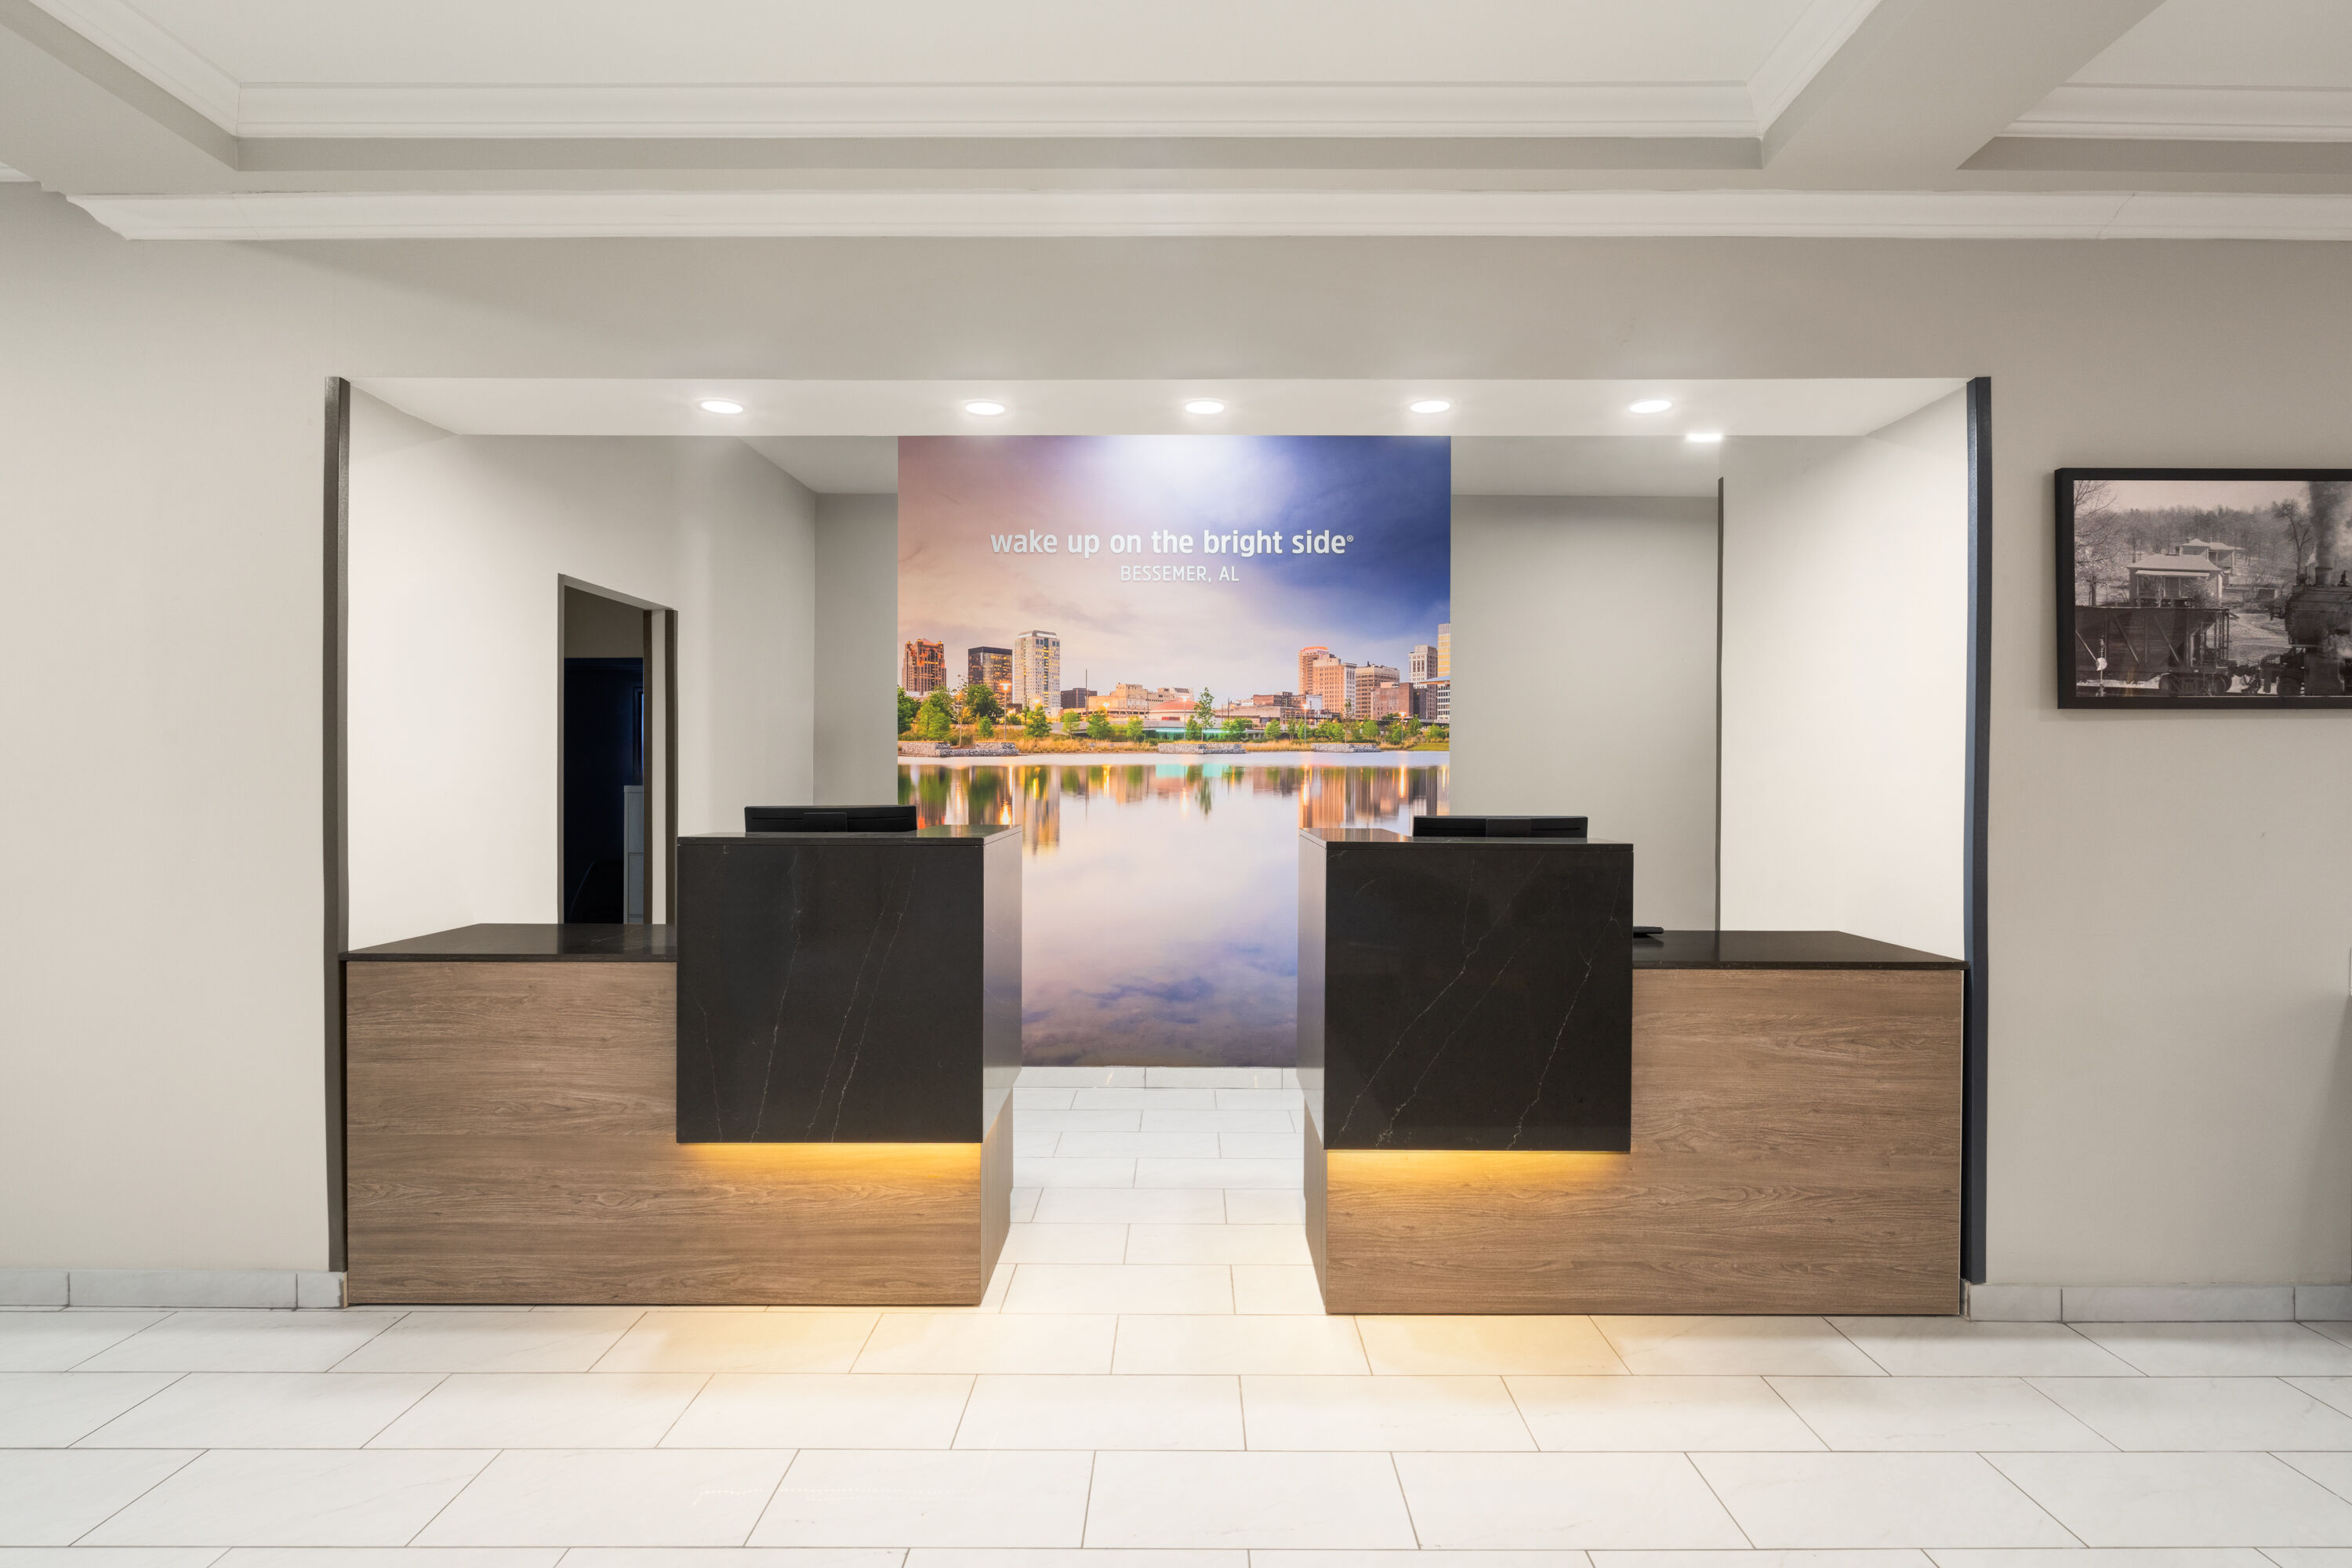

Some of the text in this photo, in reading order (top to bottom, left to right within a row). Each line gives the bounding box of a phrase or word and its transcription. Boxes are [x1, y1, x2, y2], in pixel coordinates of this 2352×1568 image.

[990, 529, 1058, 553] wake
[1067, 534, 1100, 558] up
[1109, 534, 1142, 554] on
[1151, 529, 1194, 554] the
[1203, 529, 1283, 557] bright
[1120, 565, 1240, 583] BESSEMER, AL
